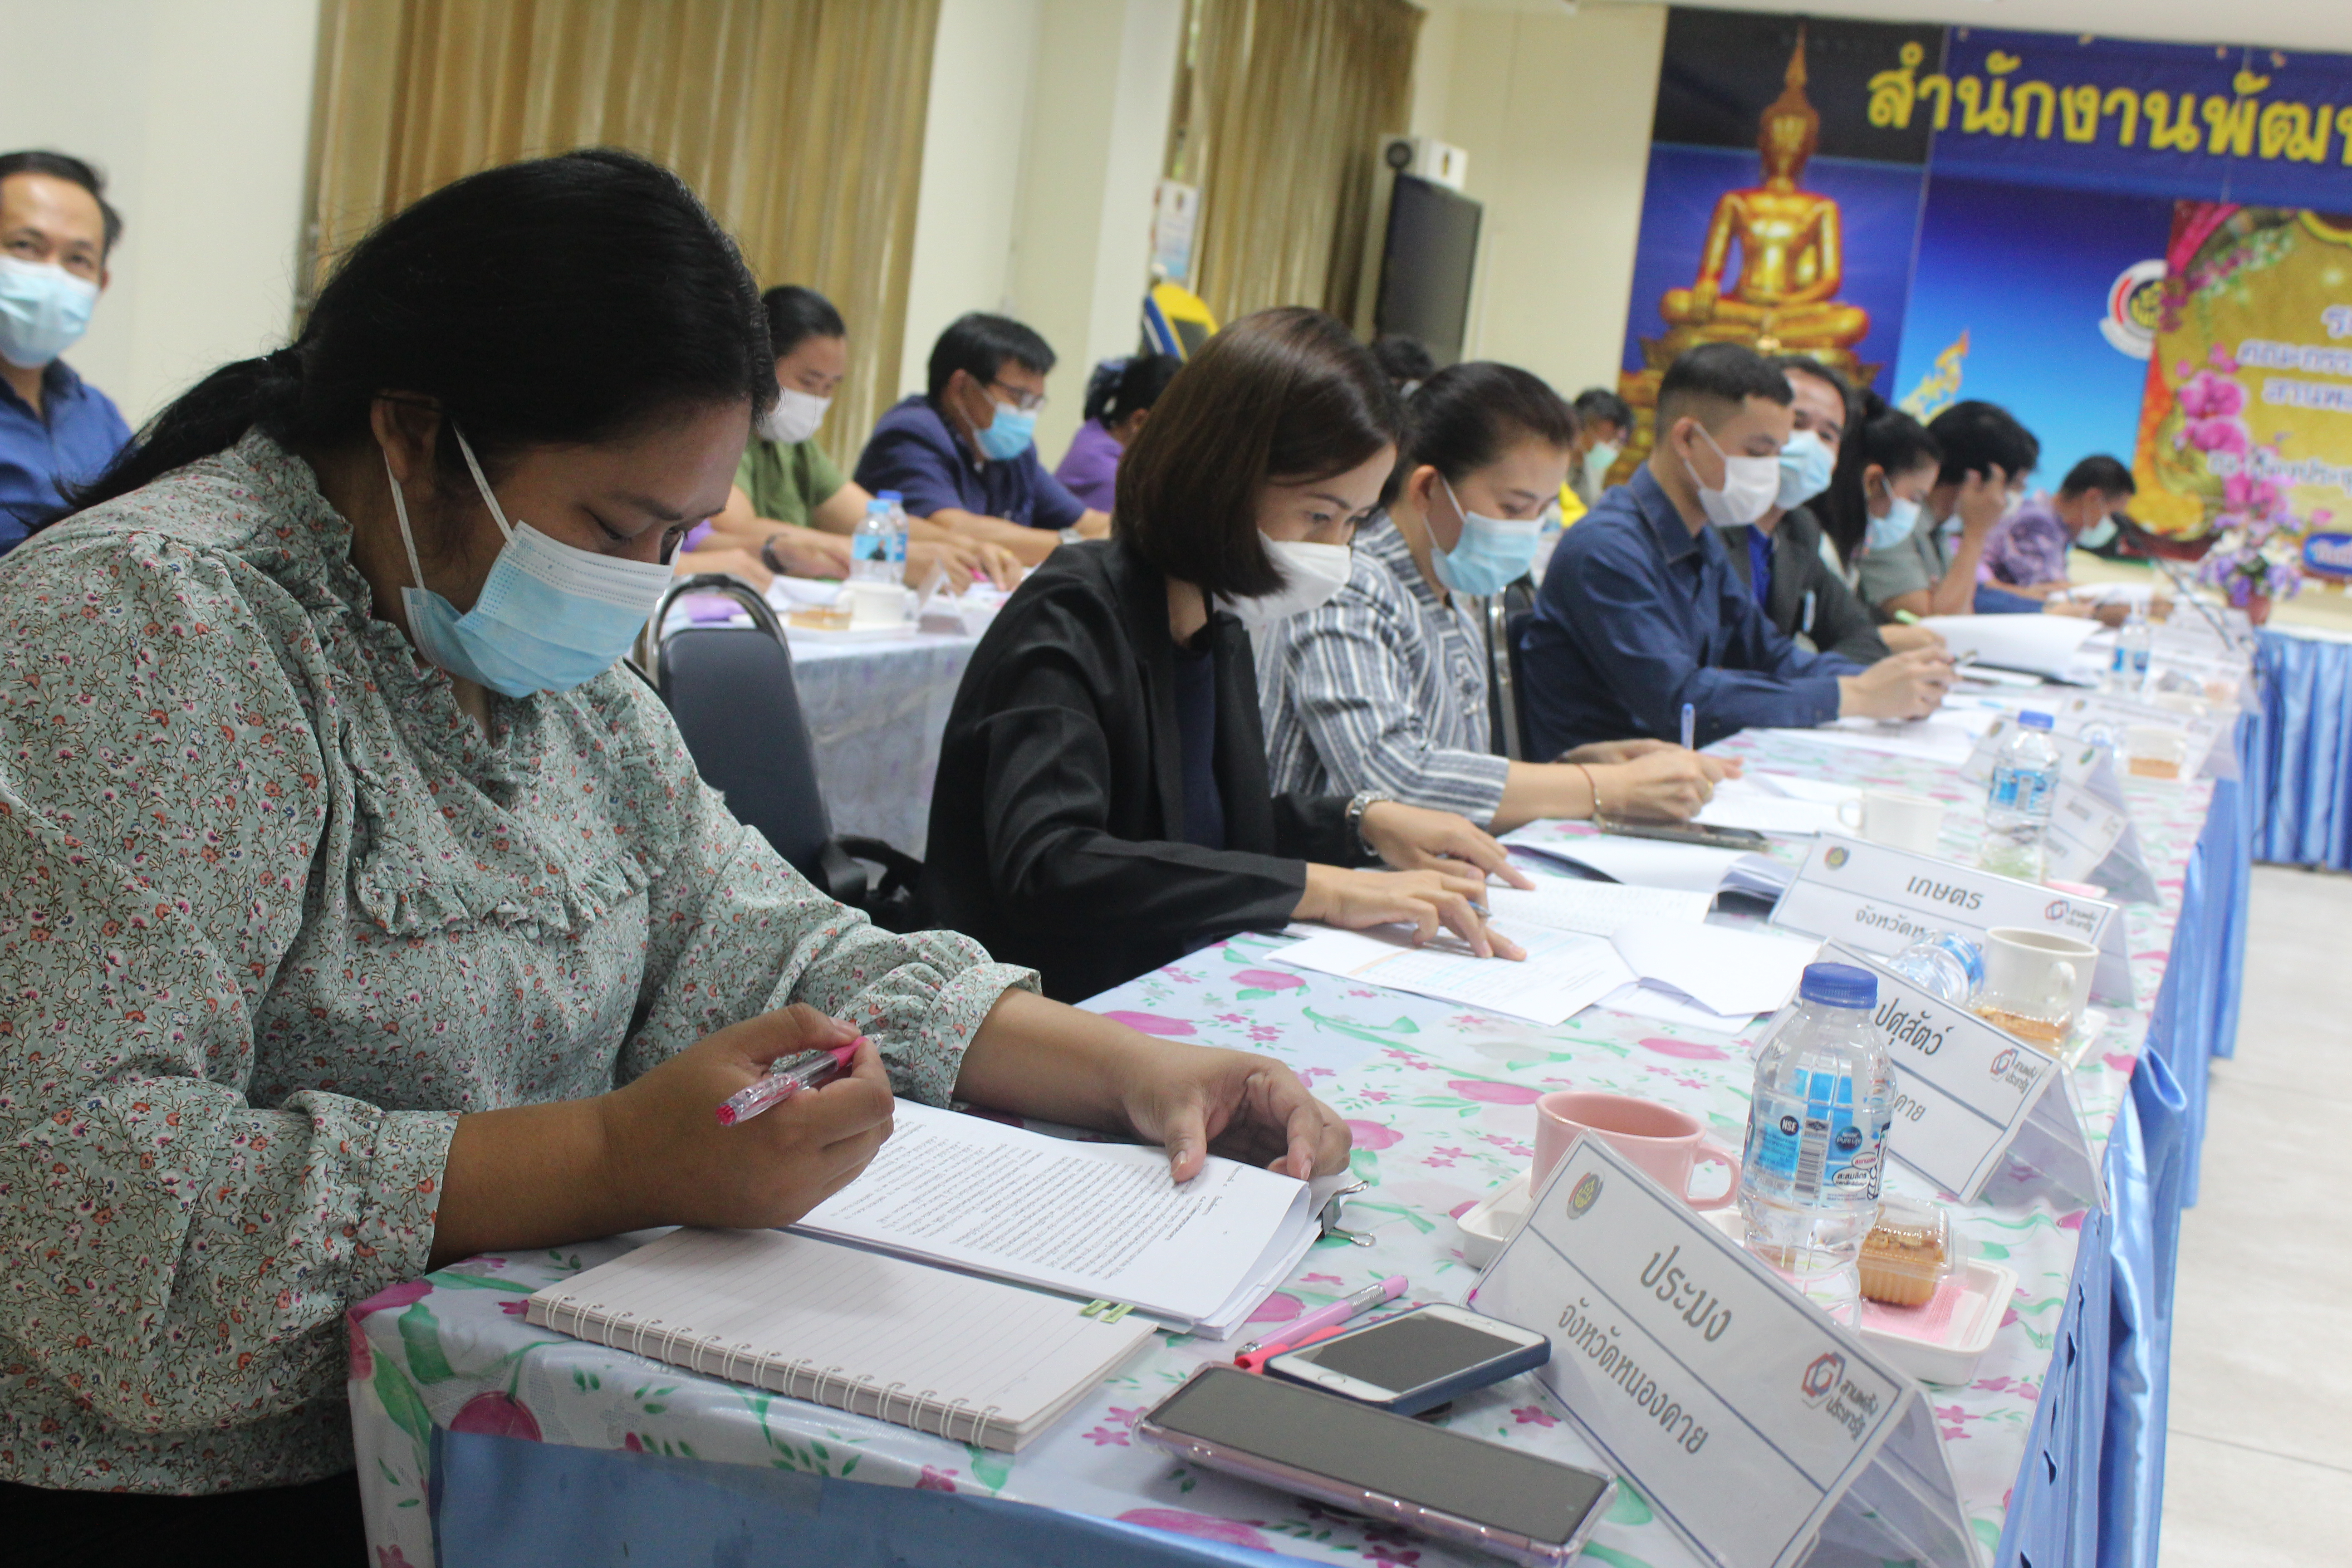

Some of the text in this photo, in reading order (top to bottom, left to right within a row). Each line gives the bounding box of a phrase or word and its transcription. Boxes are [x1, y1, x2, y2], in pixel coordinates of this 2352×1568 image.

[1906, 876, 1984, 910] เกษตร
[1875, 997, 1955, 1055] ปศุสัตว์
[1640, 1245, 1732, 1342] ประมง
[1558, 1297, 1709, 1454] จังหวัดหนองคาย
